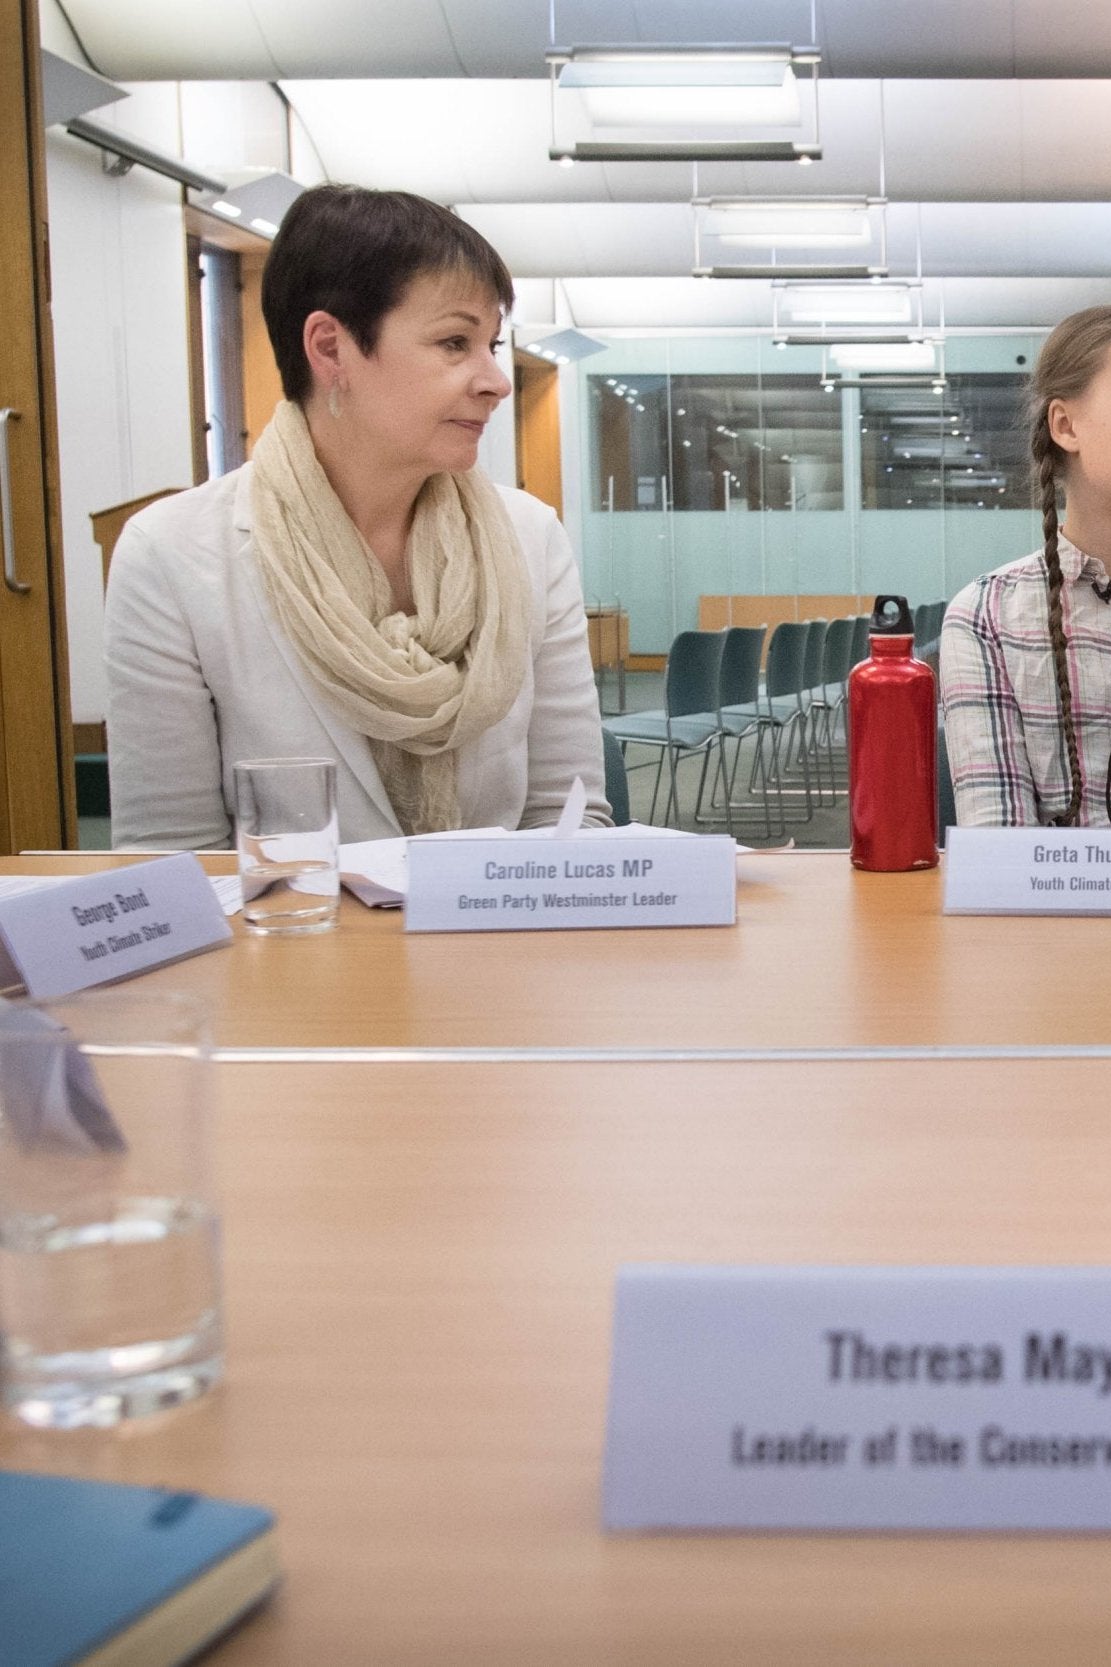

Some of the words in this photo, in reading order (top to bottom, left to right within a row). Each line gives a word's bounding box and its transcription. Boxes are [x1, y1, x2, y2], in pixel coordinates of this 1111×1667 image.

[1033, 845, 1078, 864] Greta
[485, 860, 557, 880] Caroline
[564, 860, 615, 878] Lucas
[622, 859, 653, 877] MP
[1030, 876, 1064, 891] Youth
[72, 902, 118, 926] George
[114, 887, 150, 913] Bond
[458, 894, 497, 909] Green
[502, 894, 538, 911] Party
[542, 892, 627, 908] Westminster
[632, 891, 677, 906] Leader
[107, 930, 143, 952] Climate
[141, 922, 171, 941] Striker
[825, 1328, 1004, 1384] Theresa
[731, 1421, 848, 1467] Leader
[861, 1421, 897, 1467] of
[910, 1421, 966, 1467] the
